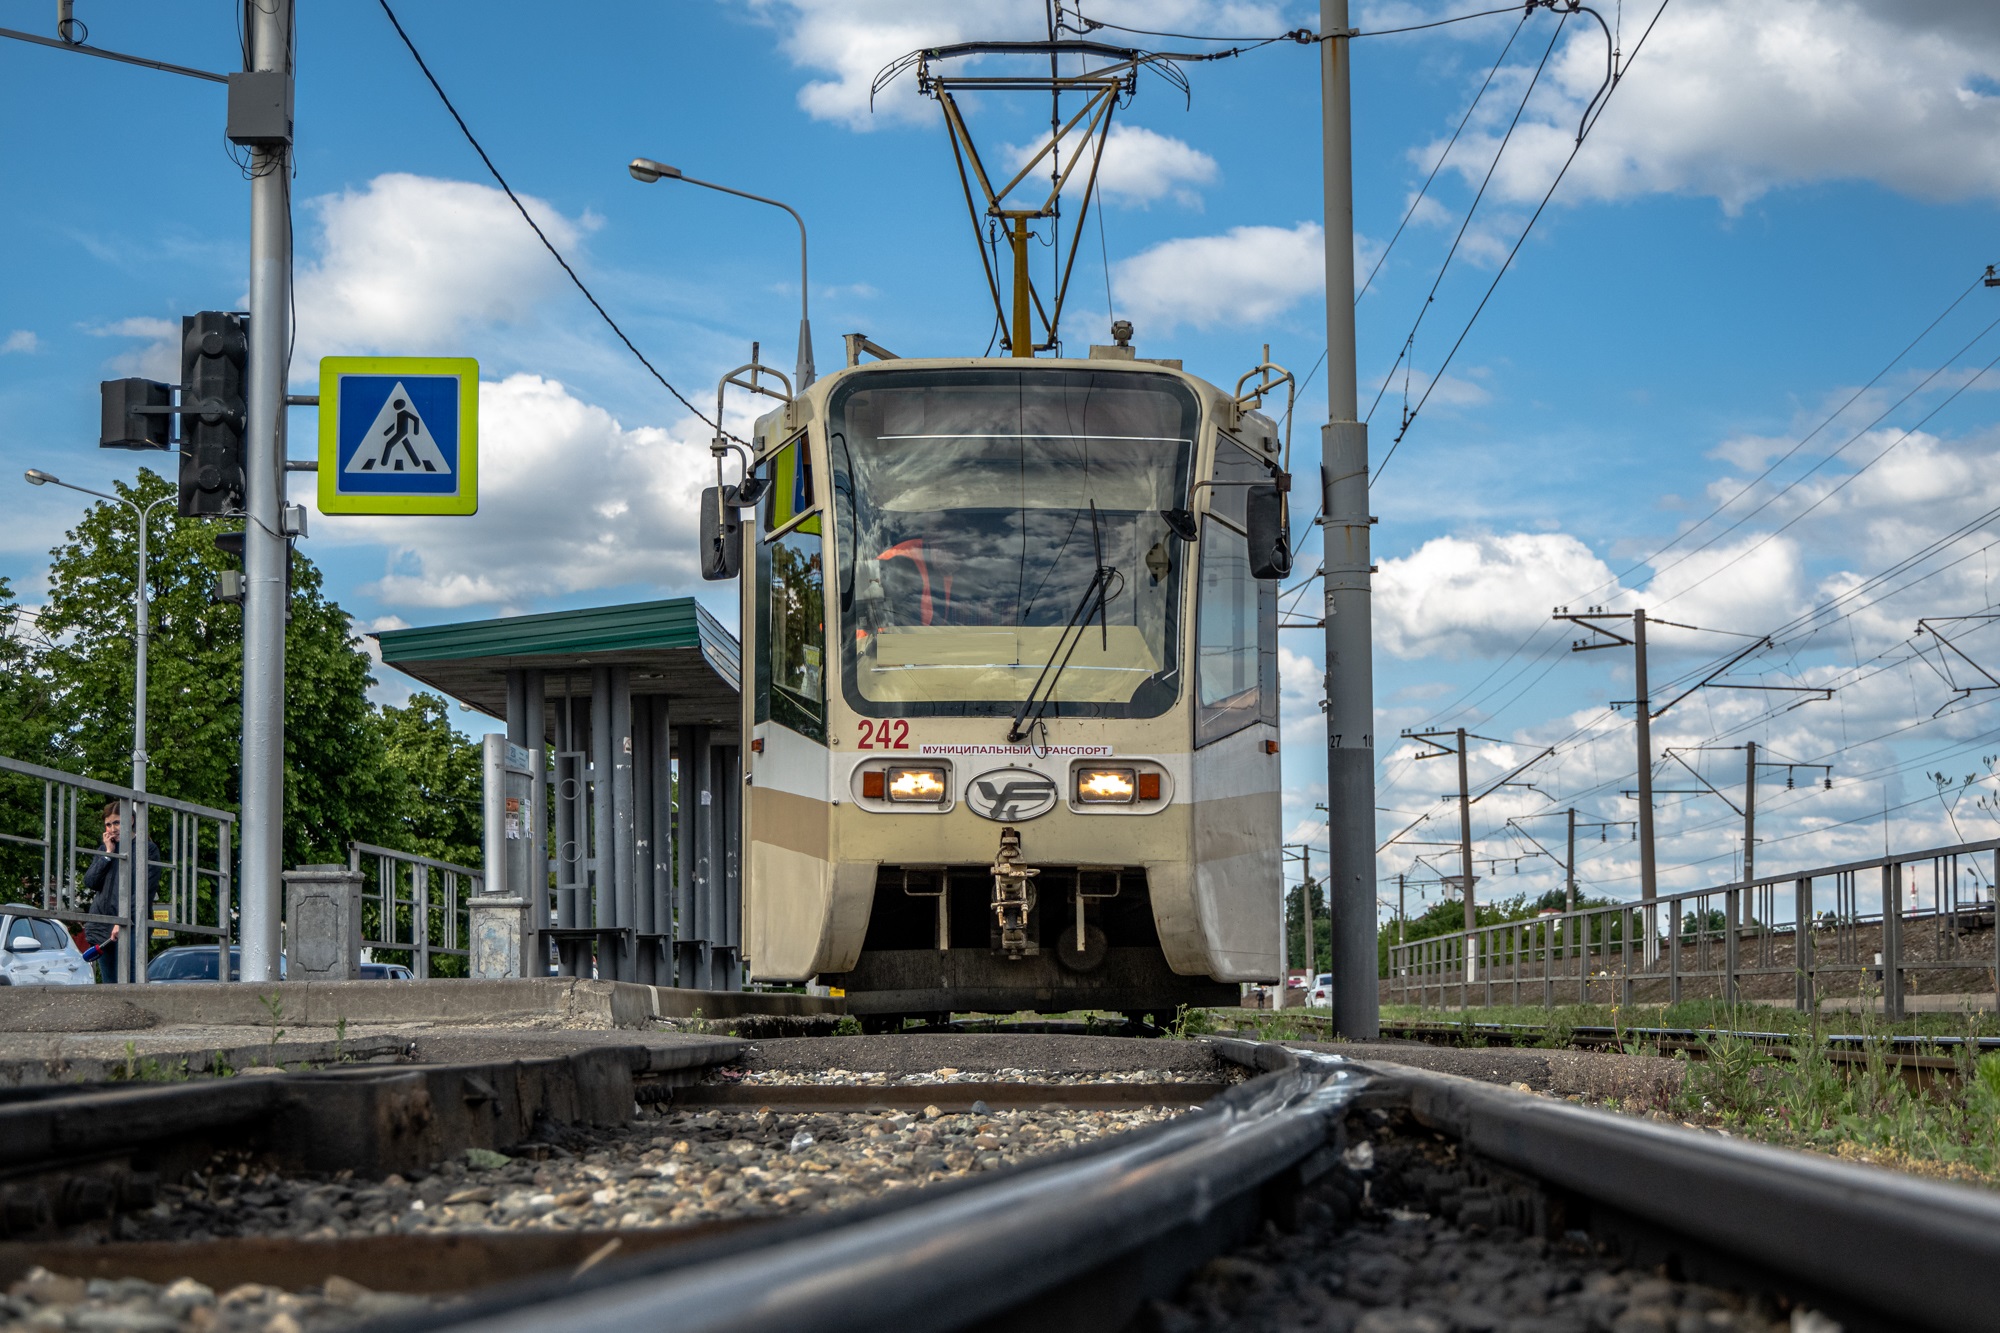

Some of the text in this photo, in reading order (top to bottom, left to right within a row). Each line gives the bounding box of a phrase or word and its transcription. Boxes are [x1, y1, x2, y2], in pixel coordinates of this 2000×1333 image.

[857, 720, 909, 749] 242
[1330, 734, 1342, 748] 27
[922, 745, 1108, 755] МУНИЦИПАЛЬНЫЙ ТРАНСПОРТ
